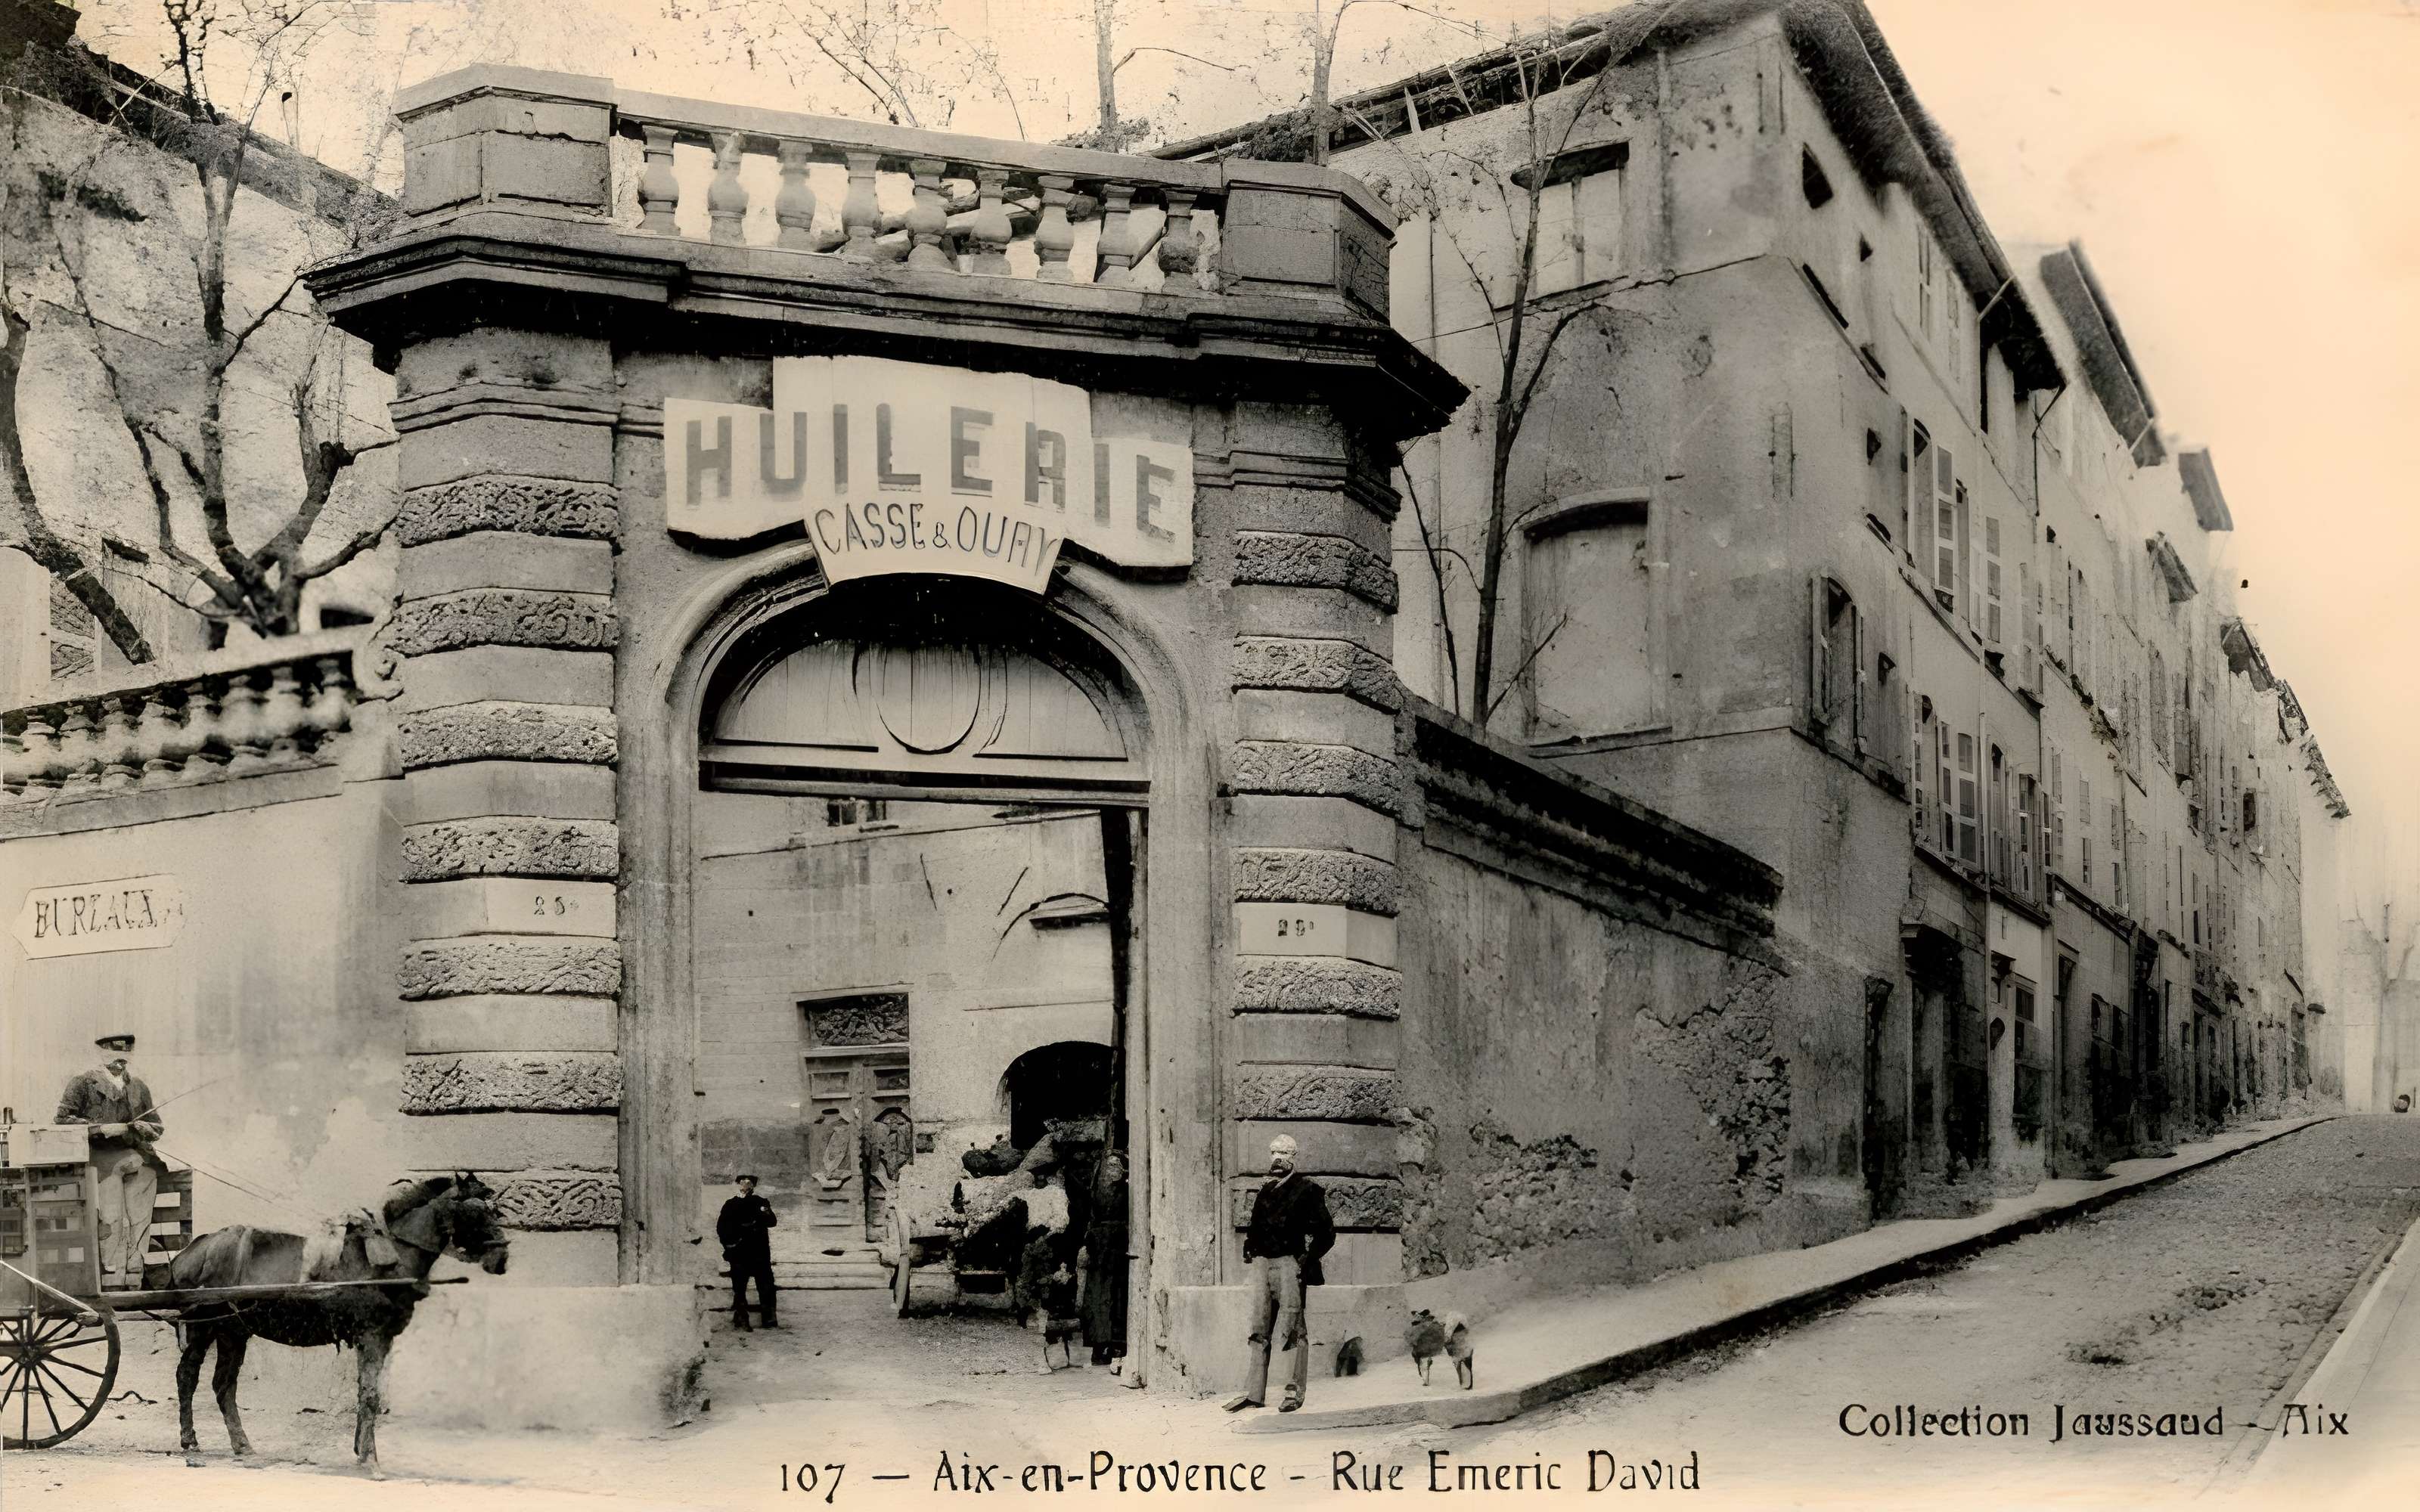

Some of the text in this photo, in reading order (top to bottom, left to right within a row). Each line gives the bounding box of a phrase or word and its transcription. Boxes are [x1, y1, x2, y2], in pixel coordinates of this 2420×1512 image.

[686, 402, 1176, 544] HUILERIE
[814, 502, 926, 555] CASSE
[932, 521, 952, 550] &
